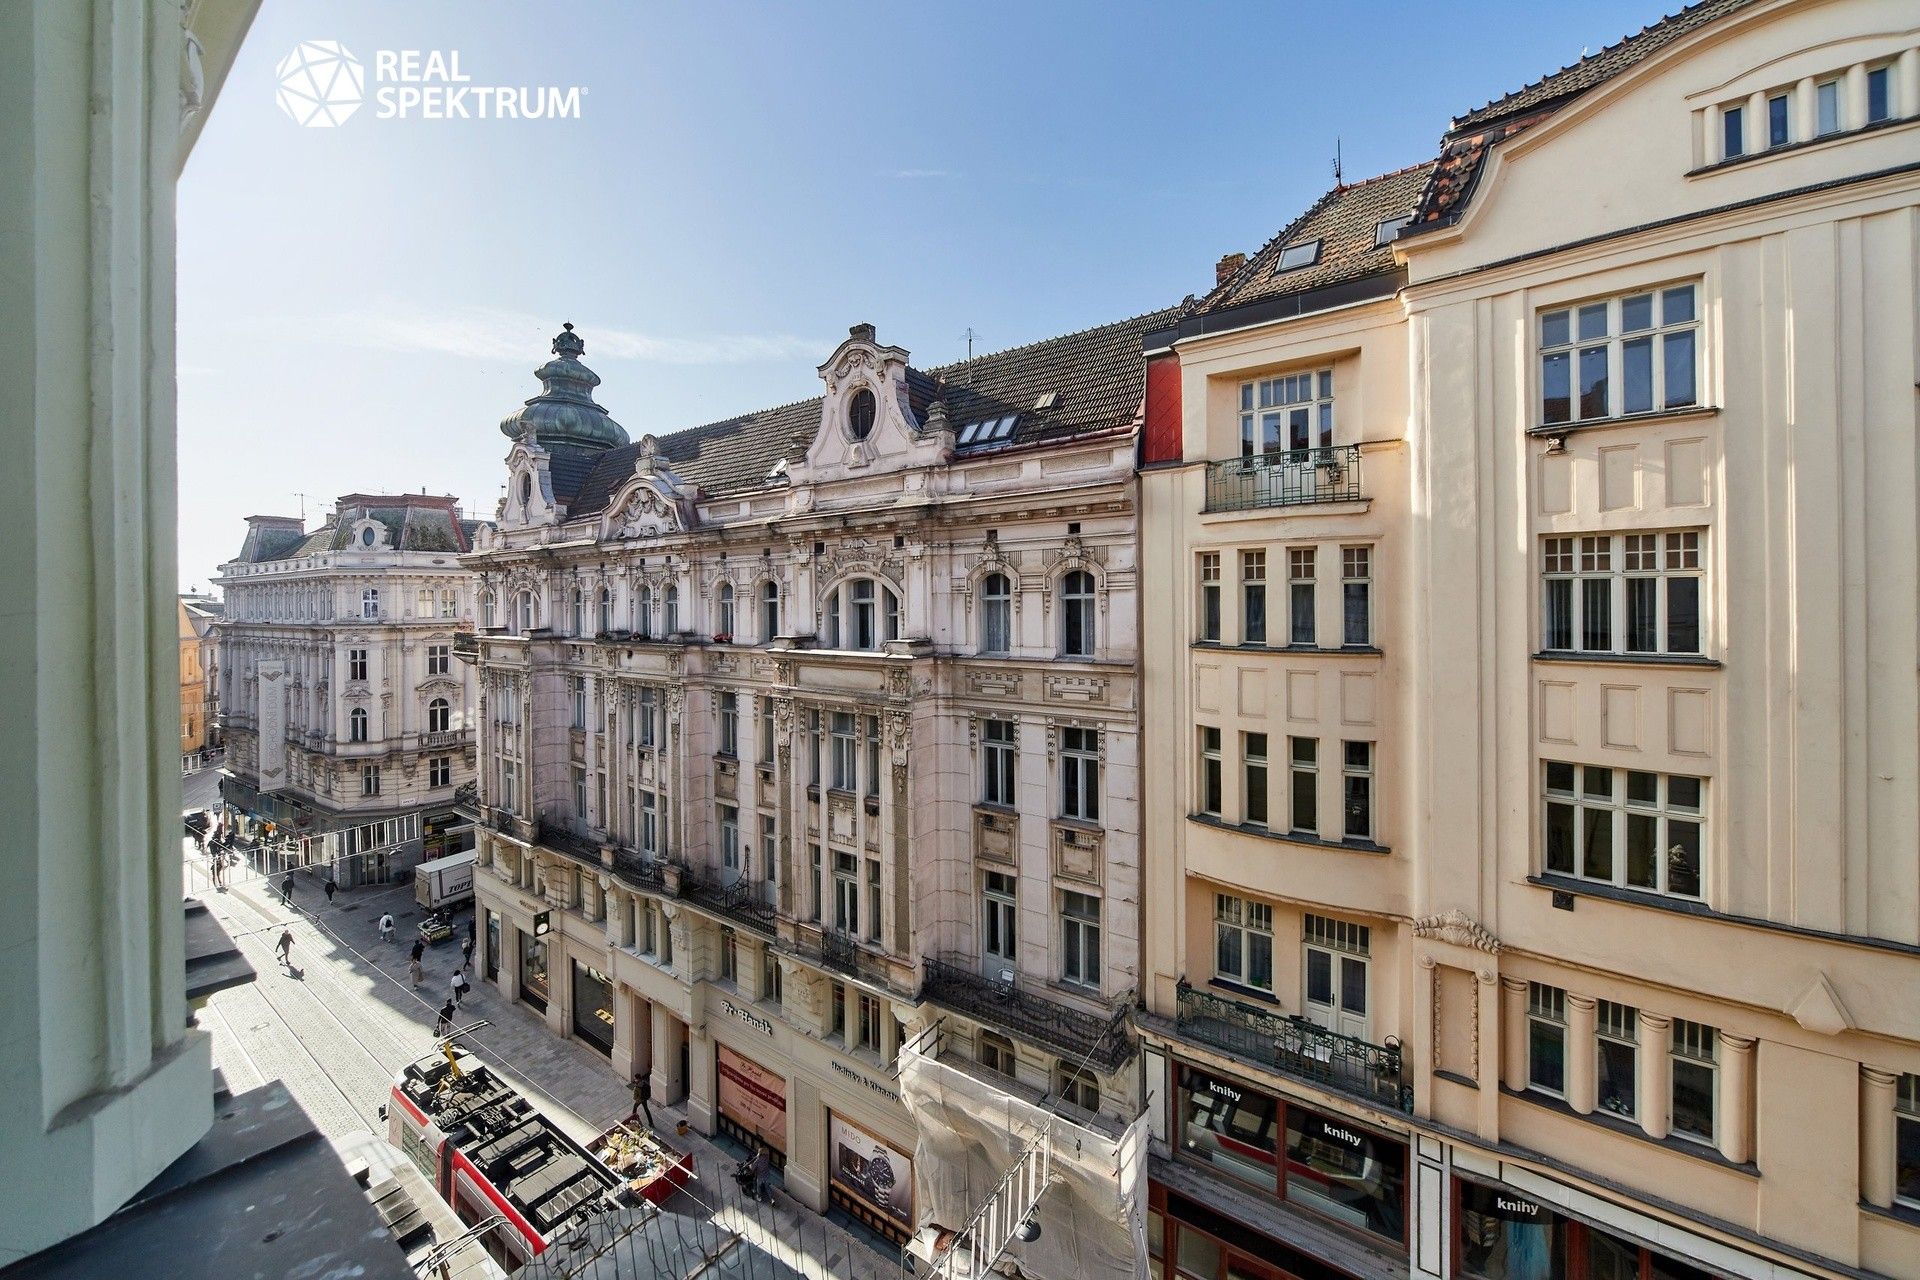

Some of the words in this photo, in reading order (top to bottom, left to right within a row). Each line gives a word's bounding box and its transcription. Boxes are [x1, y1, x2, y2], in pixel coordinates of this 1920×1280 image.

[831, 1061, 860, 1084] Hodinky
[869, 1080, 899, 1103] Klenoty
[1209, 1081, 1242, 1102] knihy
[841, 1126, 861, 1144] MIDO
[1324, 1123, 1362, 1147] knihy
[1497, 1197, 1539, 1216] knihy
